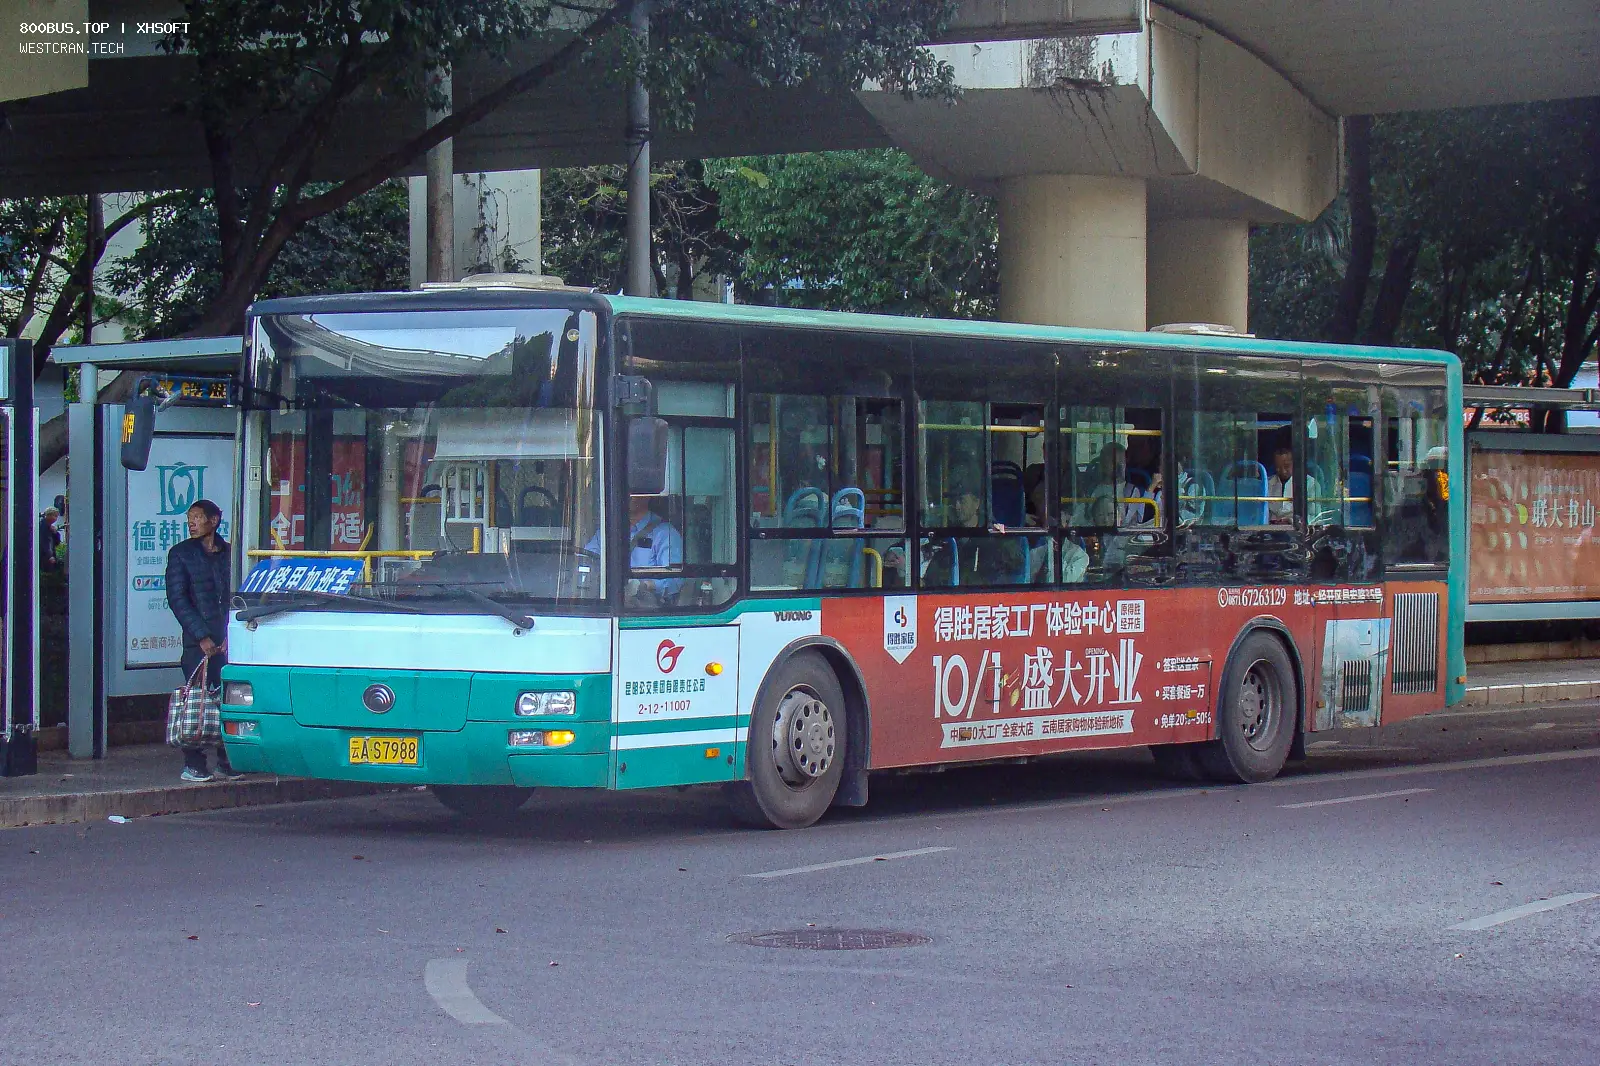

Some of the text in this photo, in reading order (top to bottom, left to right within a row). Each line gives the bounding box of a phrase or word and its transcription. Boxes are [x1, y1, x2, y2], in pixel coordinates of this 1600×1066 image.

[1532, 498, 1600, 528] 联大书山
[132, 519, 229, 551] 德韩
[243, 565, 356, 594] 111路甲加班车
[1242, 588, 1286, 606] 67263129
[773, 610, 813, 622] YUTONG
[933, 600, 1116, 643] 得胜居家工厂体验中心
[625, 678, 706, 696] 昆明公交集团有限责任公司
[1021, 639, 1144, 711] 盛大开业
[1162, 684, 1206, 700] 买套餐返一万
[1041, 714, 1125, 735] 云南居家购物体验新地标
